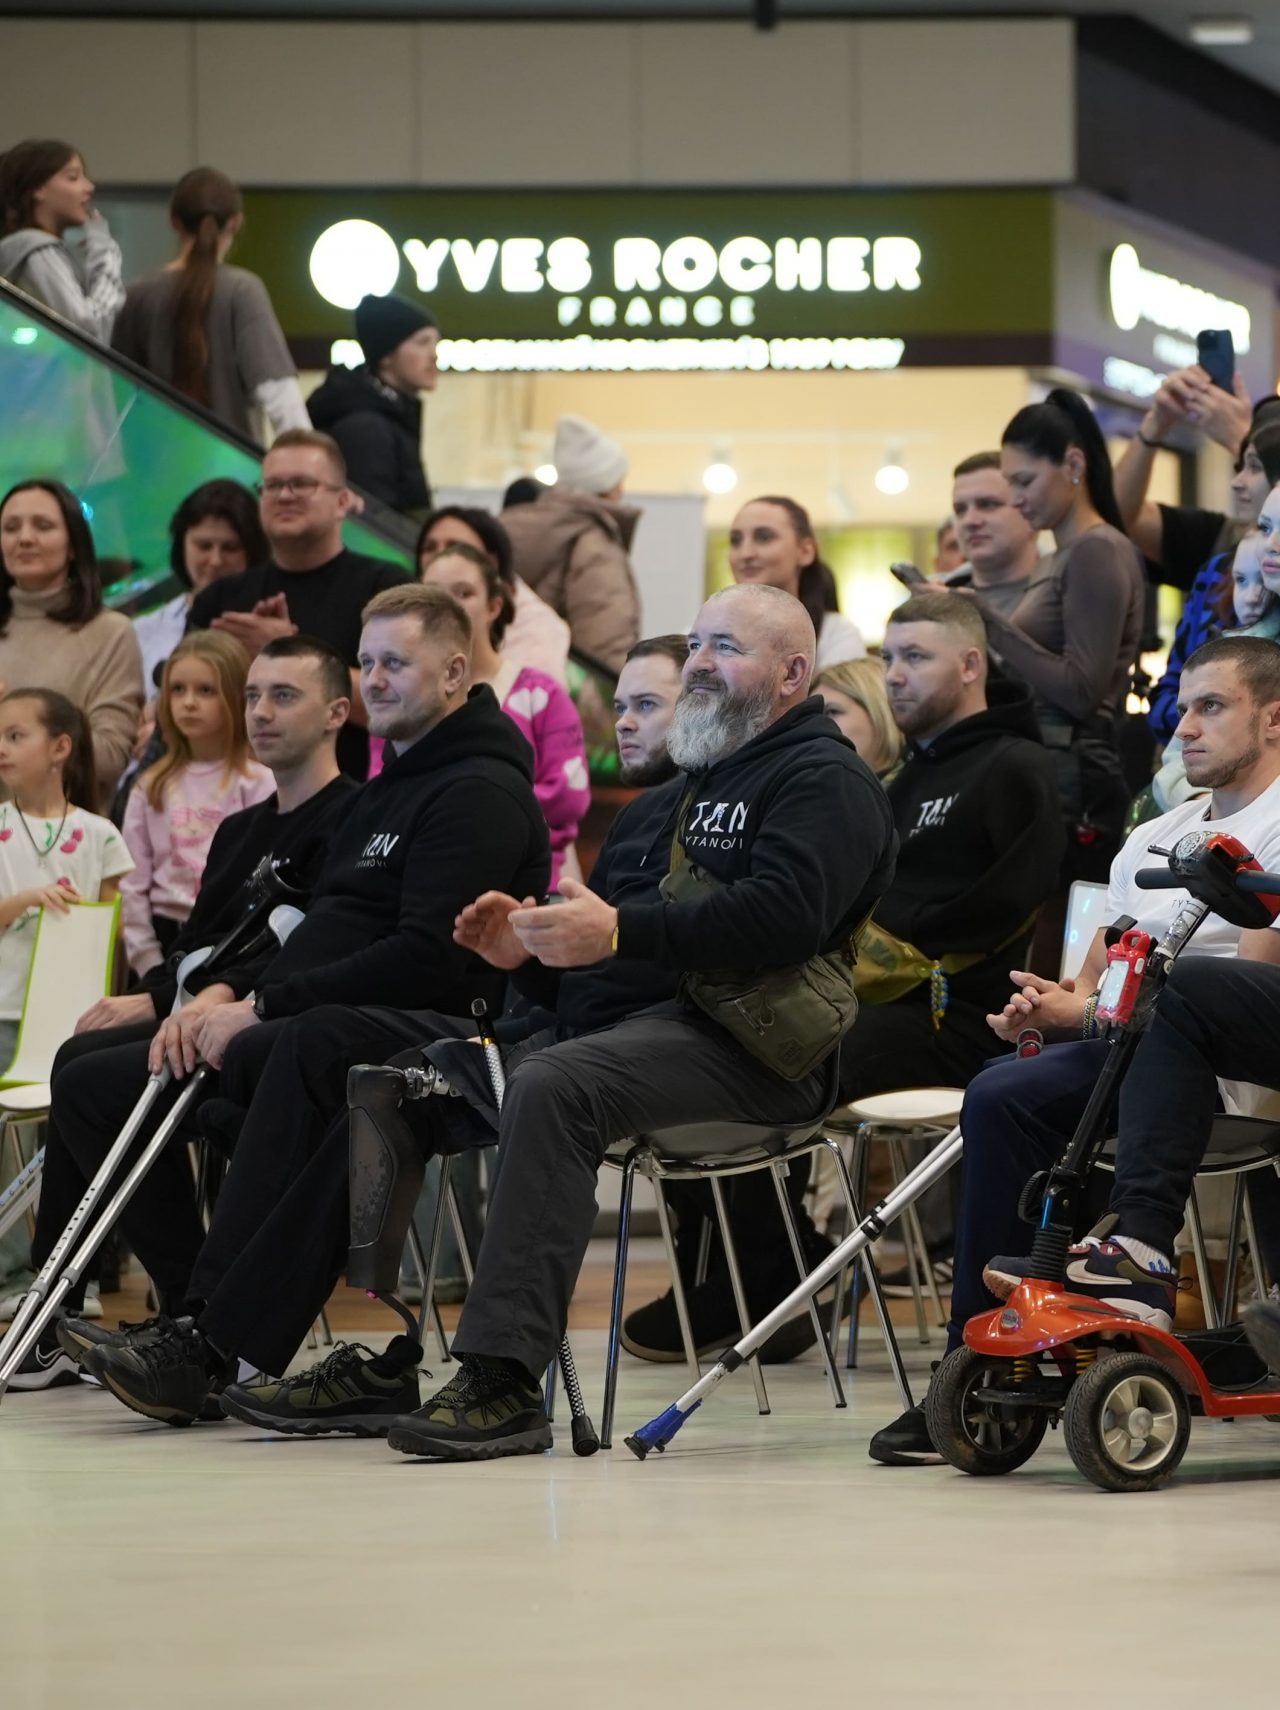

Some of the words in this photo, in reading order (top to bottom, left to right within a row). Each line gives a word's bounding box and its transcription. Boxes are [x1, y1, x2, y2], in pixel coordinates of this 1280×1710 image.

[403, 236, 592, 292] YVES
[613, 236, 921, 292] ROCHER
[557, 295, 756, 327] FRANCE
